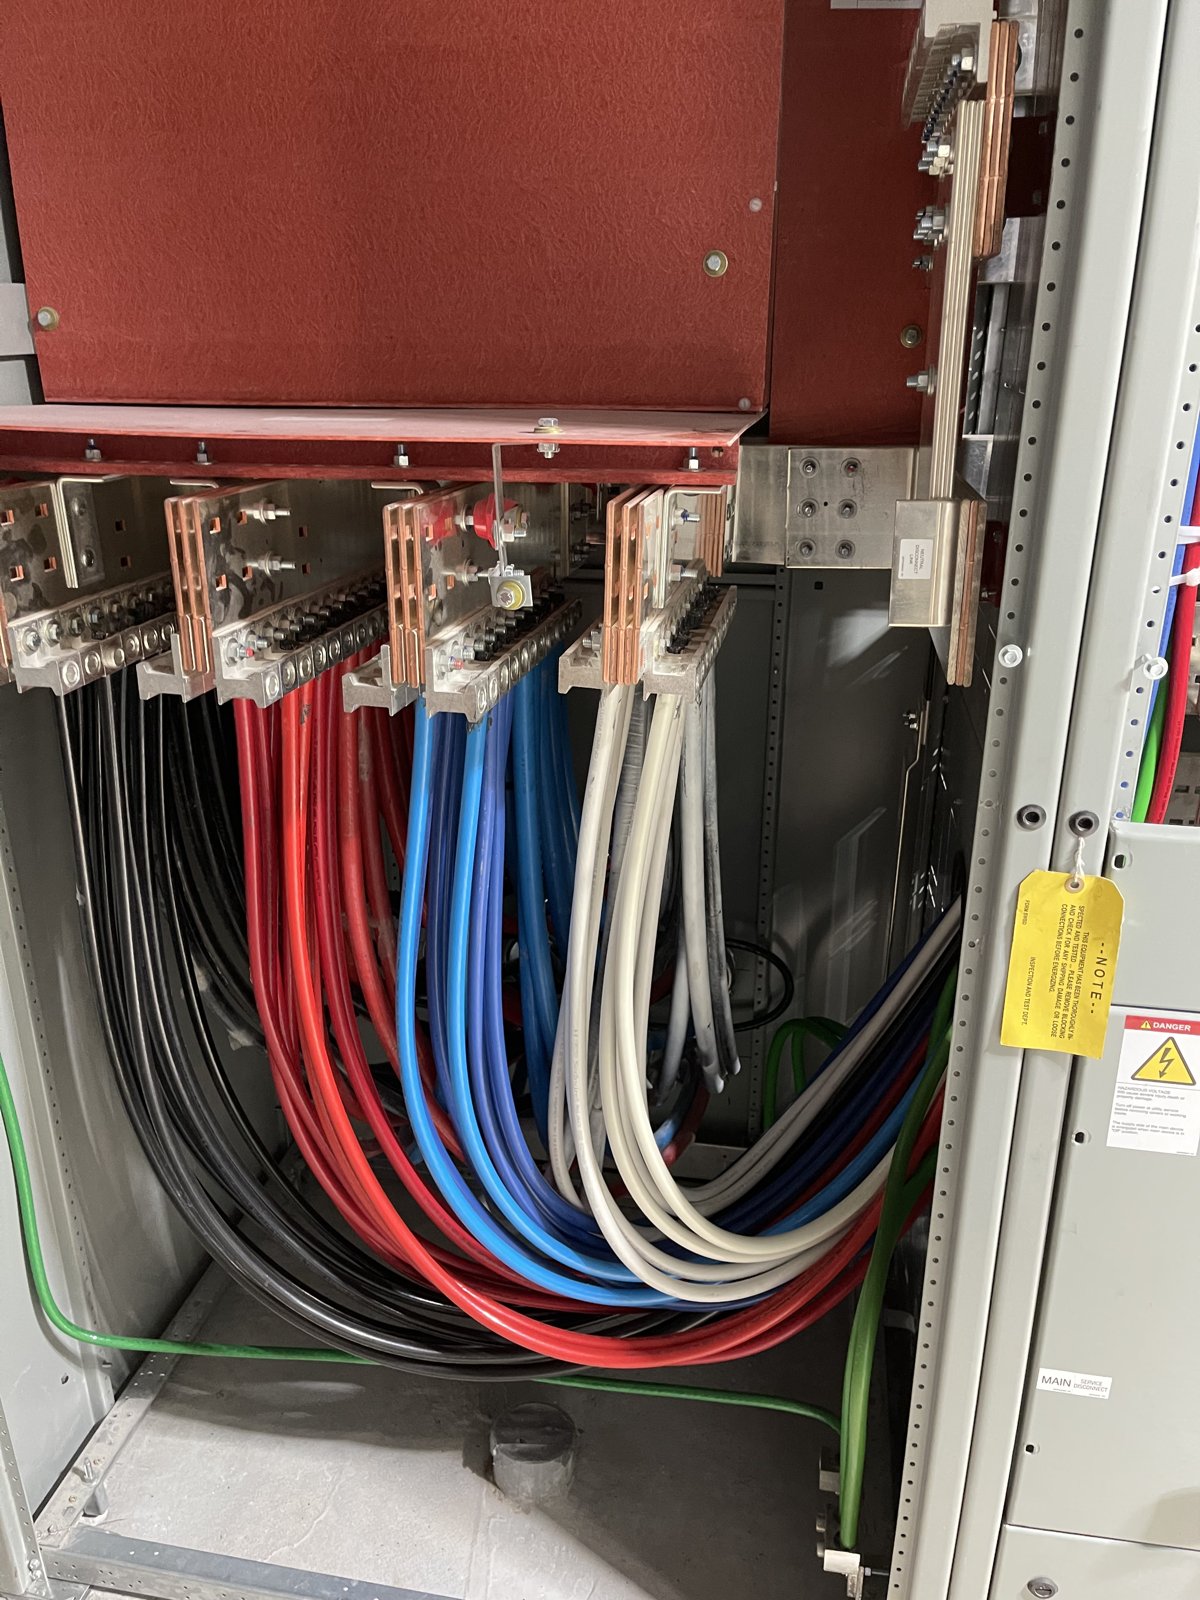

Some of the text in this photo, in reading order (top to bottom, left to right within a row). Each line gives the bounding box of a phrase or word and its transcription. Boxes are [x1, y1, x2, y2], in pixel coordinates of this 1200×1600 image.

[1056, 903, 1067, 940] CONNECTIONS
[1075, 905, 1084, 929] SPECTED
[1073, 930, 1081, 942] AND
[1053, 940, 1062, 961] BEFORE
[1062, 950, 1070, 960] ANY
[1070, 943, 1078, 962] TESTED
[1077, 944, 1087, 973] EQUIPMENT
[1026, 957, 1036, 986] INSPECTION
[1058, 962, 1068, 986] SHIPPING
[1066, 970, 1075, 990] PLEASE
[1055, 988, 1064, 1009] DAMAGE
[1063, 991, 1071, 1012] REMOVE
[1073, 985, 1081, 999] BEEN
[1053, 1011, 1060, 1019] OR
[1068, 1000, 1078, 1033] THOROUGHLY
[1050, 1020, 1058, 1038] LOOSE
[1059, 1013, 1068, 1039] BLOCKING
[1153, 1021, 1191, 1032] DANGER
[1041, 1375, 1071, 1387] MAIN
[1073, 1383, 1108, 1392] DISCONNECT
